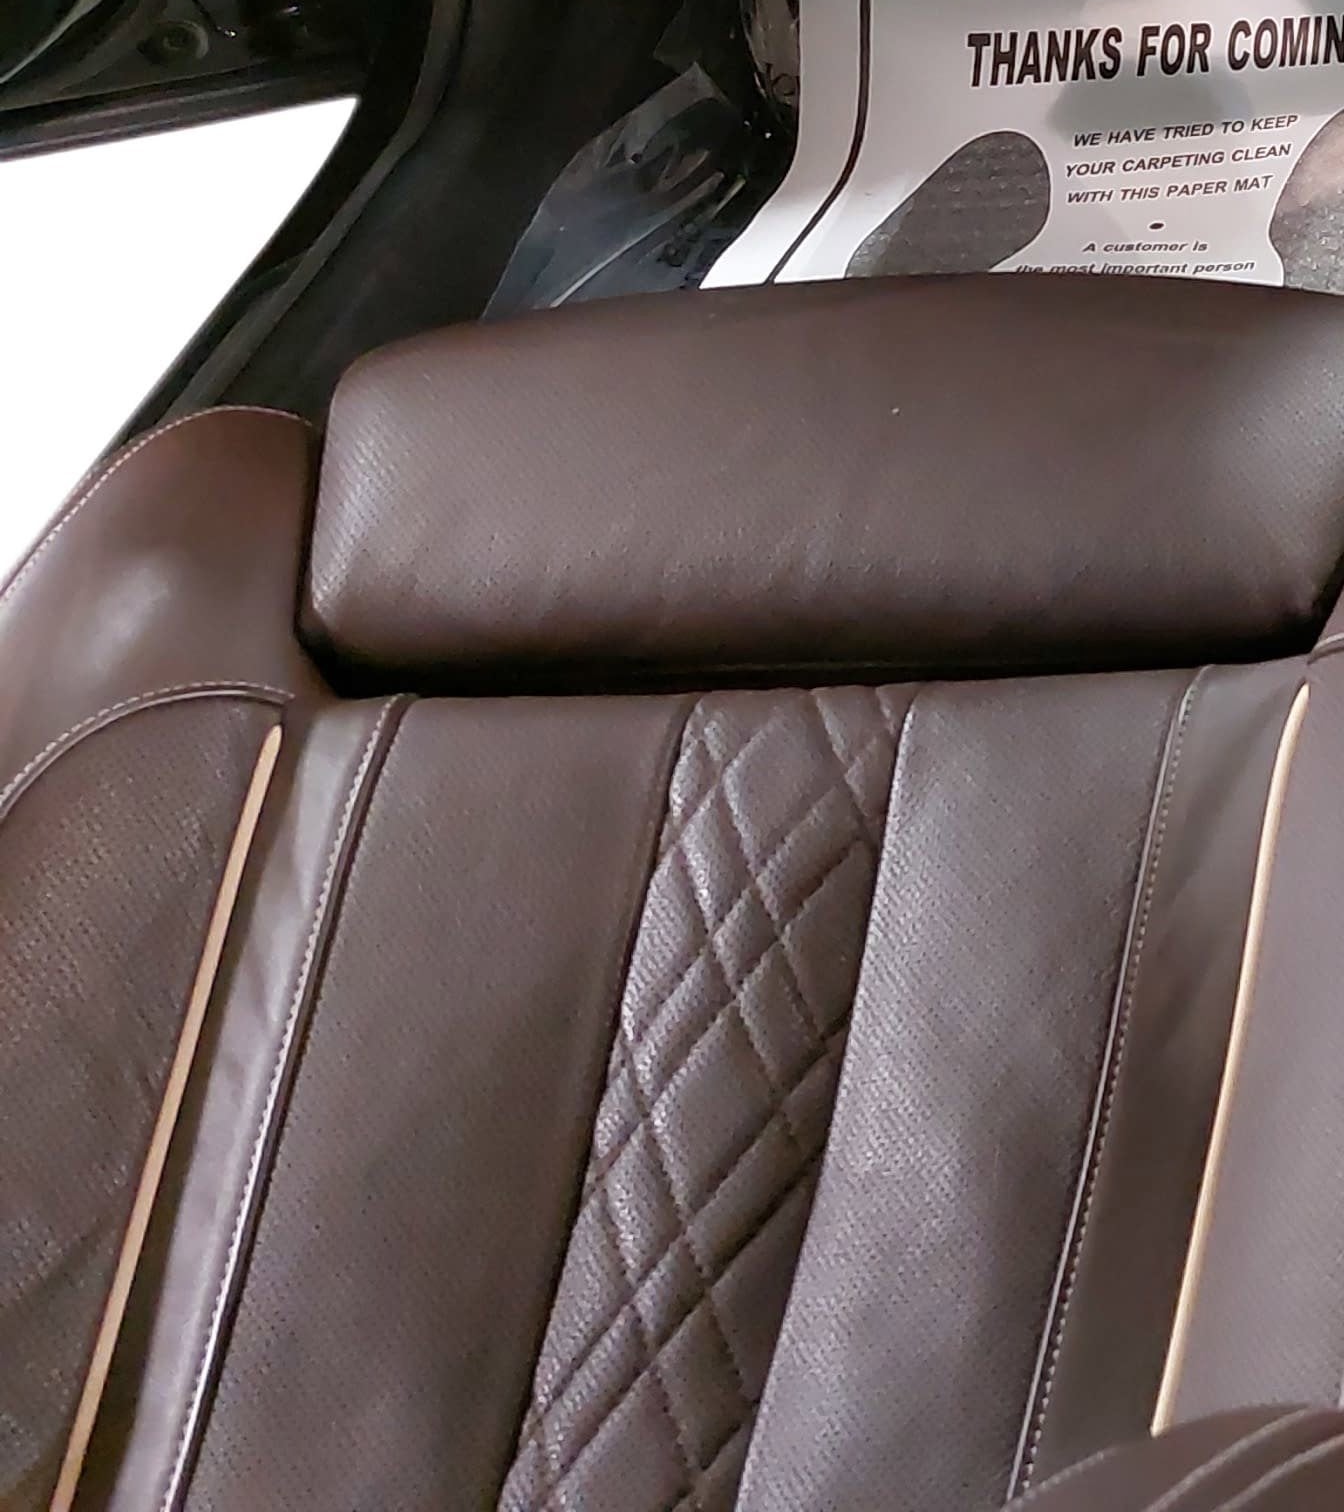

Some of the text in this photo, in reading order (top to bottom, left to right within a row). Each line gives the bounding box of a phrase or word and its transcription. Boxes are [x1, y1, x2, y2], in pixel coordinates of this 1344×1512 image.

[967, 25, 1122, 88] THANKS
[1137, 22, 1212, 77] FOR
[1073, 114, 1299, 148] WE HAVE TRIED TO KEEP
[1065, 143, 1292, 178] YOUR CARPETING CLEAN
[1067, 174, 1273, 204] WITH THIS PAPER MAT
[1082, 240, 1208, 253] A customer is
[1050, 262, 1095, 275] most
[1100, 262, 1188, 275] important
[1193, 261, 1255, 276] person
